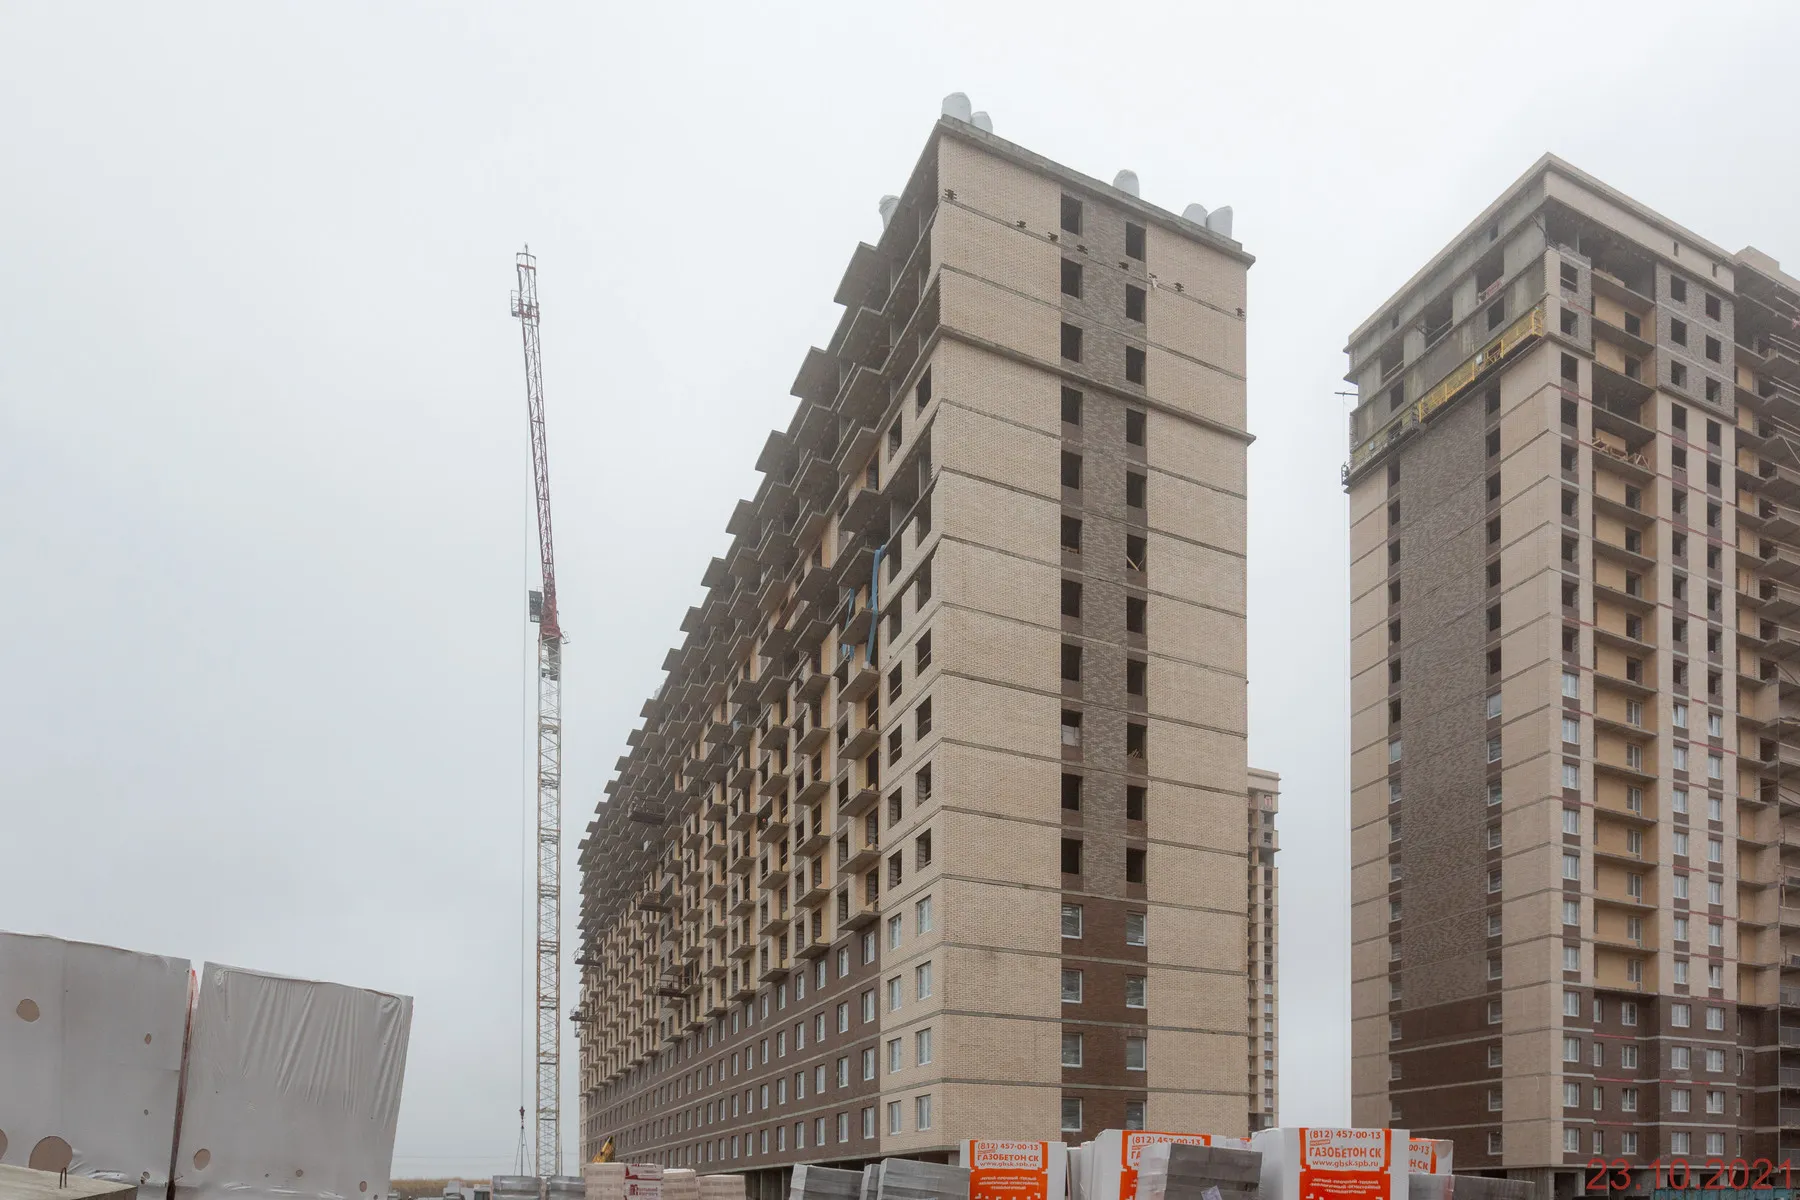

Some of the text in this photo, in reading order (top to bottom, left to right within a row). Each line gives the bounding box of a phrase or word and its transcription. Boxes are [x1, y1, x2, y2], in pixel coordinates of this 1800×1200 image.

[1310, 1130, 1333, 1139] (812)
[1132, 1136, 1155, 1144] (812)
[1309, 1147, 1382, 1158] ГАЗОБЕТОН СК
[977, 1153, 1027, 1161] ГАЗОБЕТОН
